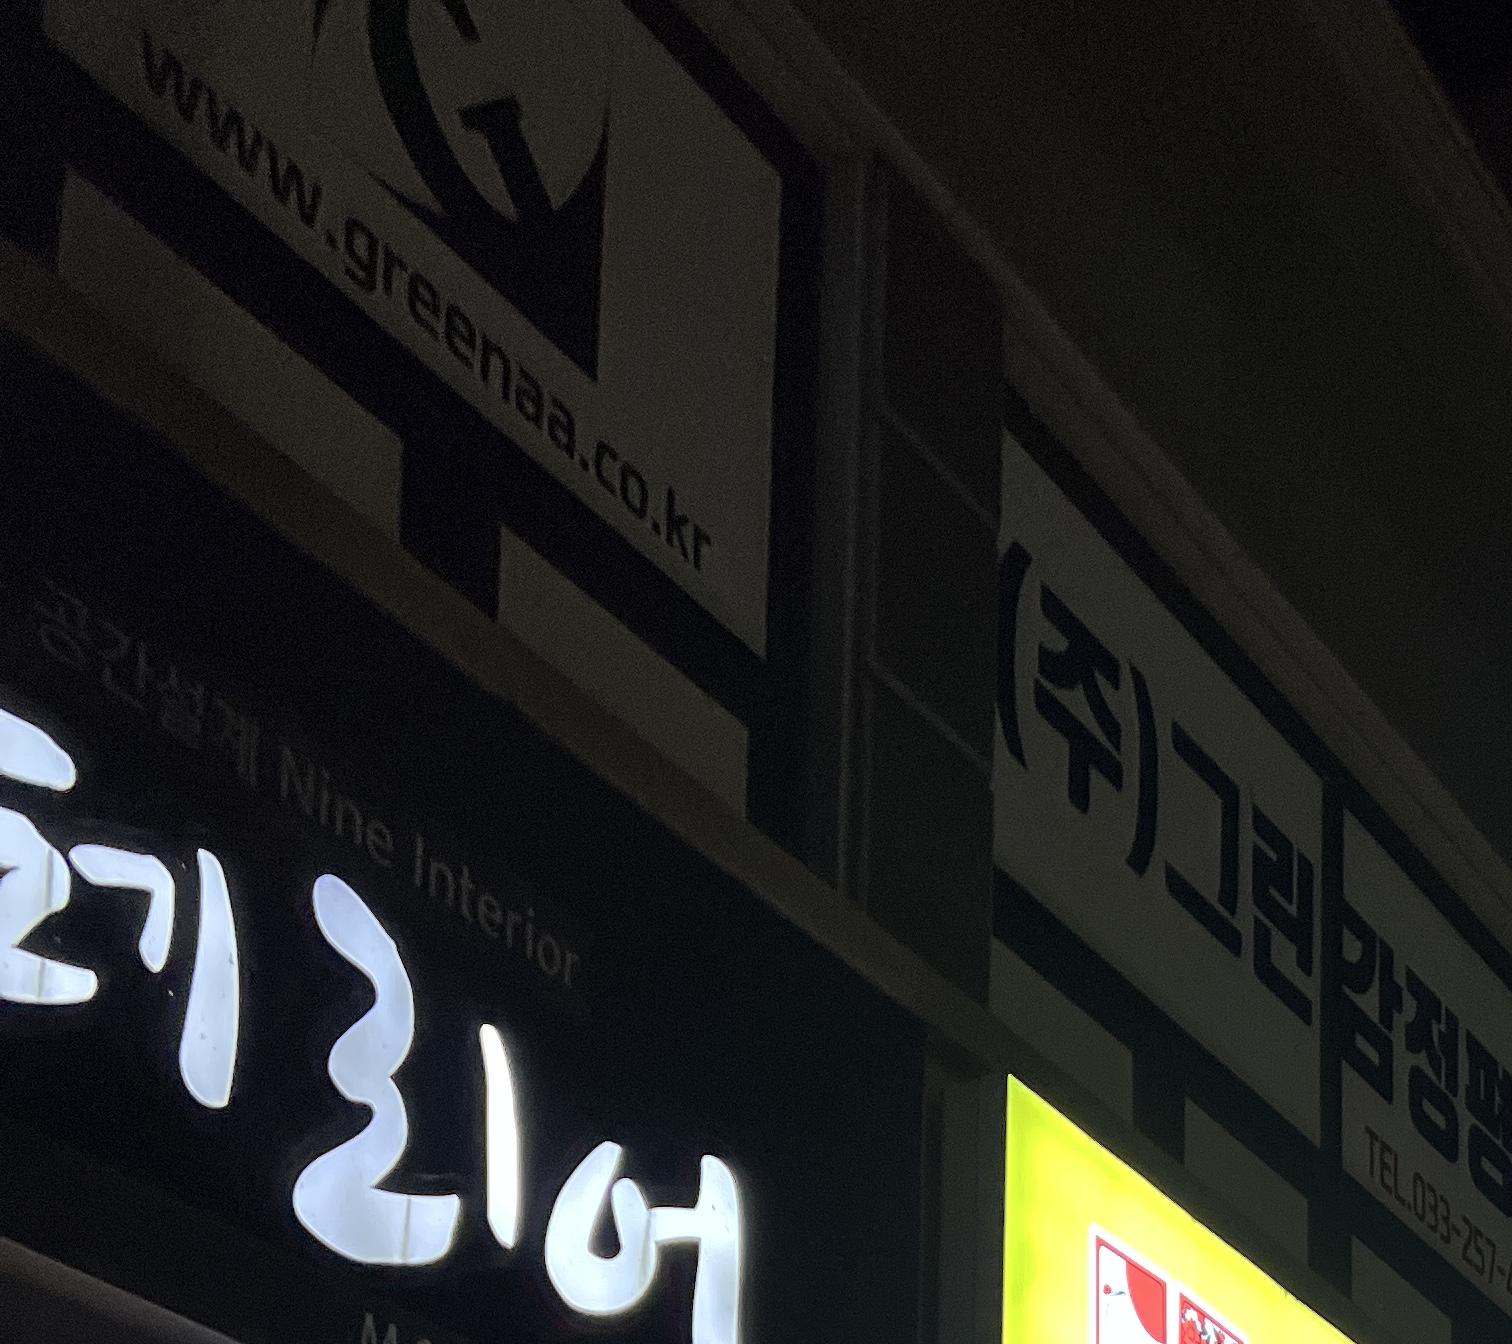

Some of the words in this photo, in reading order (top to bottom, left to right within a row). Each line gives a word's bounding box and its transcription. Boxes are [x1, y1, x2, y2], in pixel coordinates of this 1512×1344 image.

[140, 26, 713, 573] www.greenaa.co.kr
[278, 744, 394, 869] Nine
[413, 834, 582, 988] Interior
